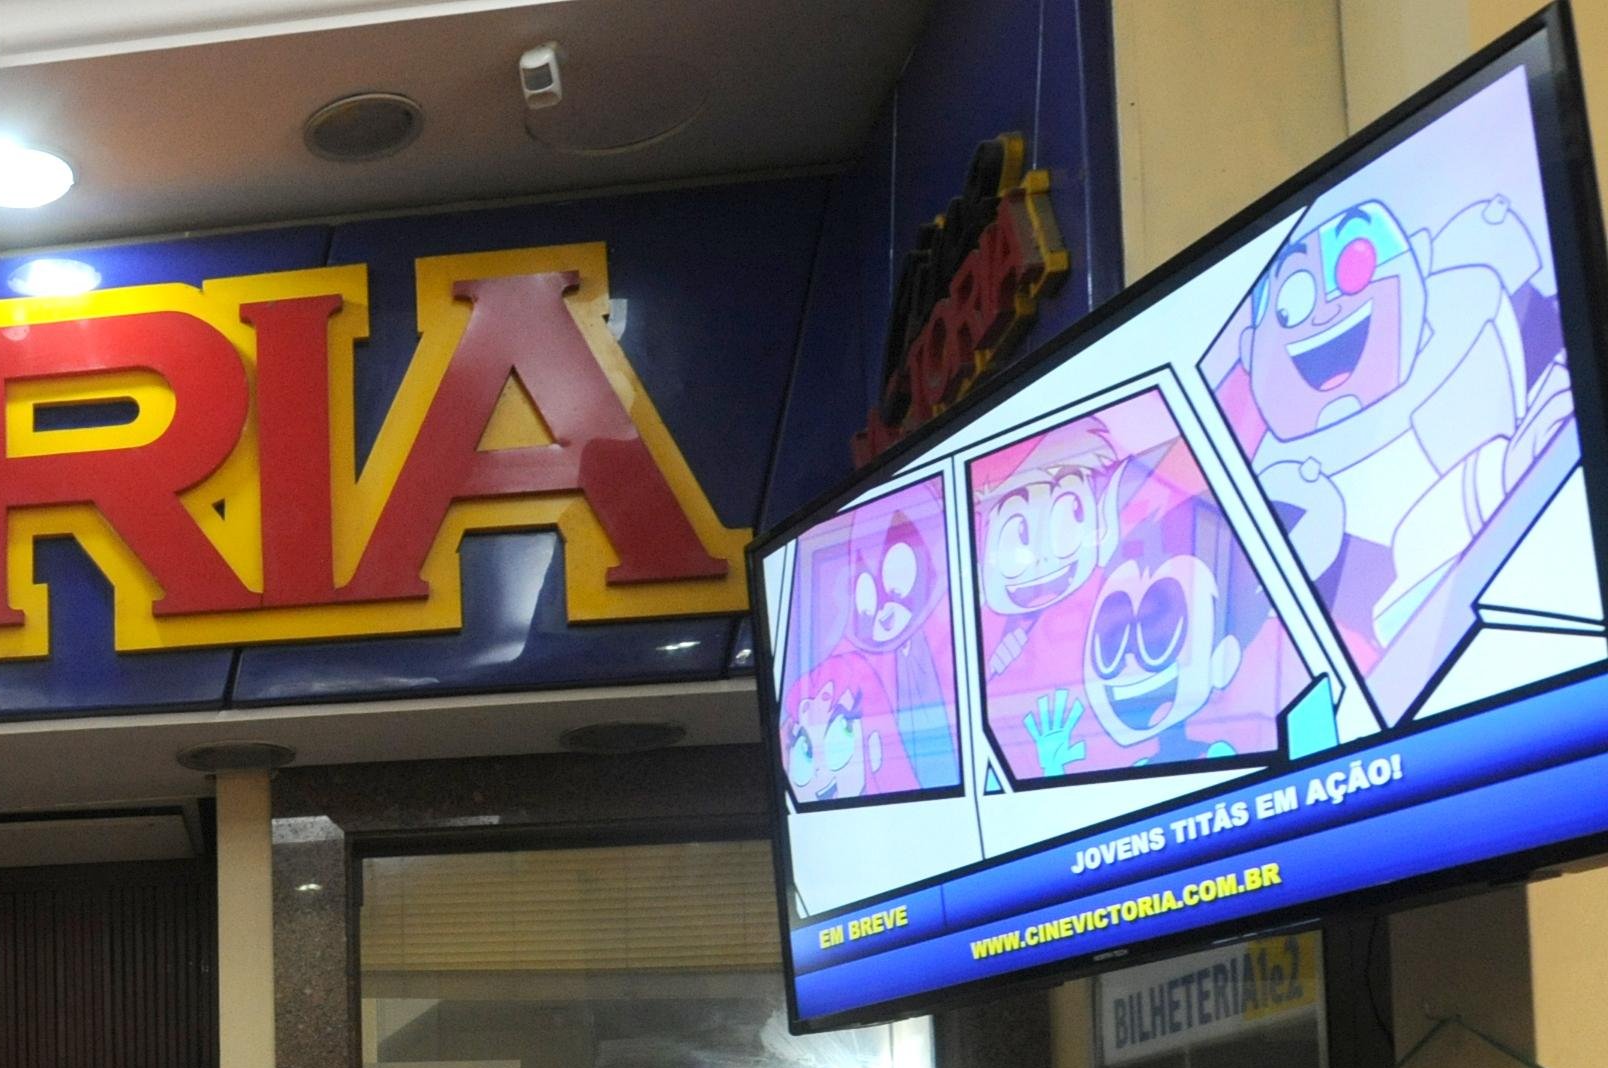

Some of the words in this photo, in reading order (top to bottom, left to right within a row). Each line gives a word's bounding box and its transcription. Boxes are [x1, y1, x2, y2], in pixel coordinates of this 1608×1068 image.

[1071, 826, 1167, 874] JOVENS
[1170, 801, 1250, 844] TITÃS
[1255, 786, 1298, 820] EM
[1306, 753, 1404, 805] AÇÃO!
[819, 923, 845, 950] EM
[848, 904, 909, 941] BREVE
[969, 862, 1283, 960] WWW.CINEVICTORIA.COM.BR
[1113, 951, 1257, 1049] BILHETERIA
